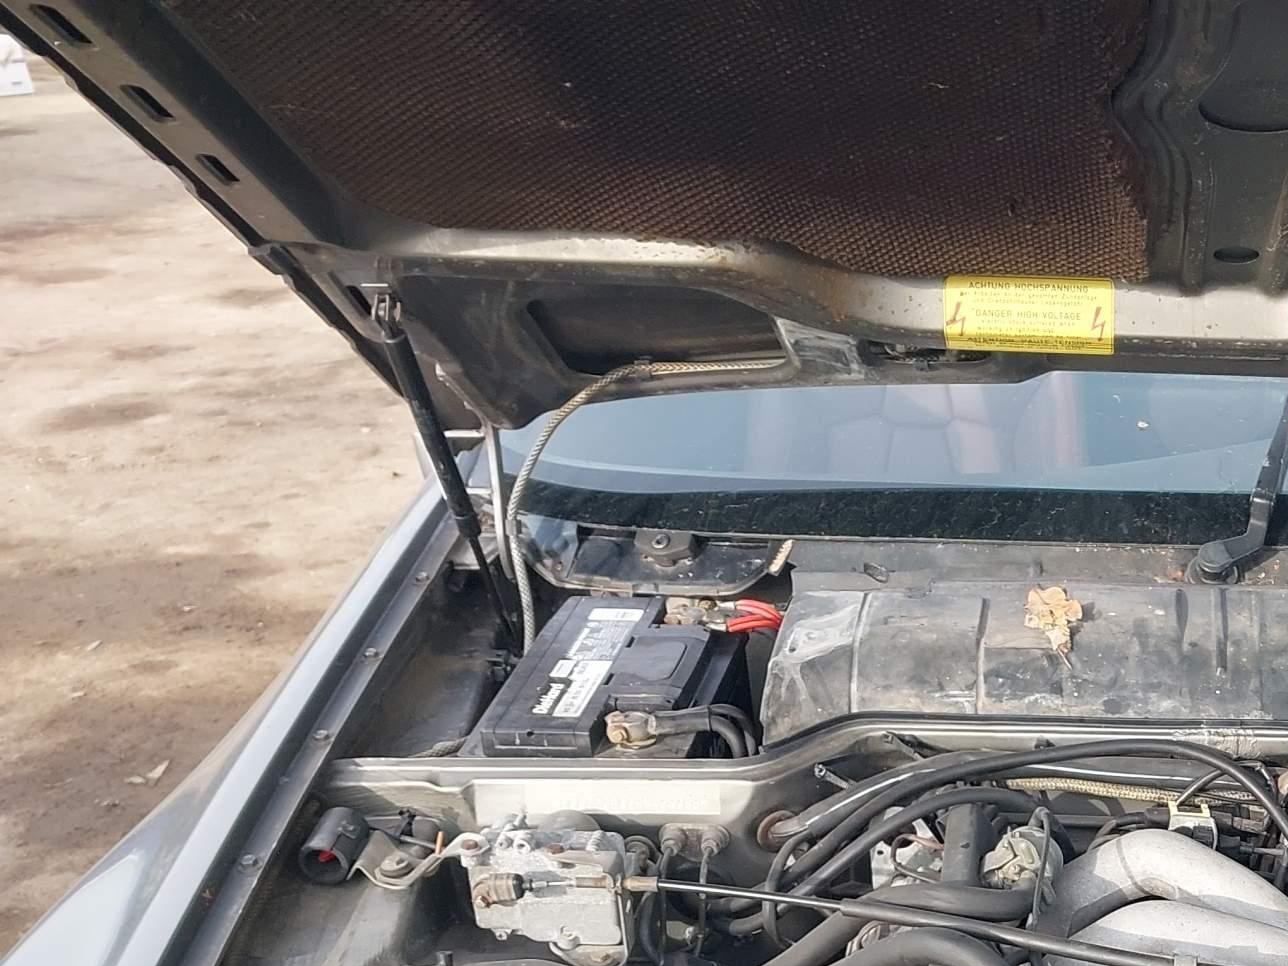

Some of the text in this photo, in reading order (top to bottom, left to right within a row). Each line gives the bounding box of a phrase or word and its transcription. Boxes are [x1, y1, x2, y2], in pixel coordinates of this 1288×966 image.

[968, 281, 1089, 293] ACHTUNG HOCHSPANNUNG
[975, 309, 1081, 321] DANGER HIGH VOLTAGE
